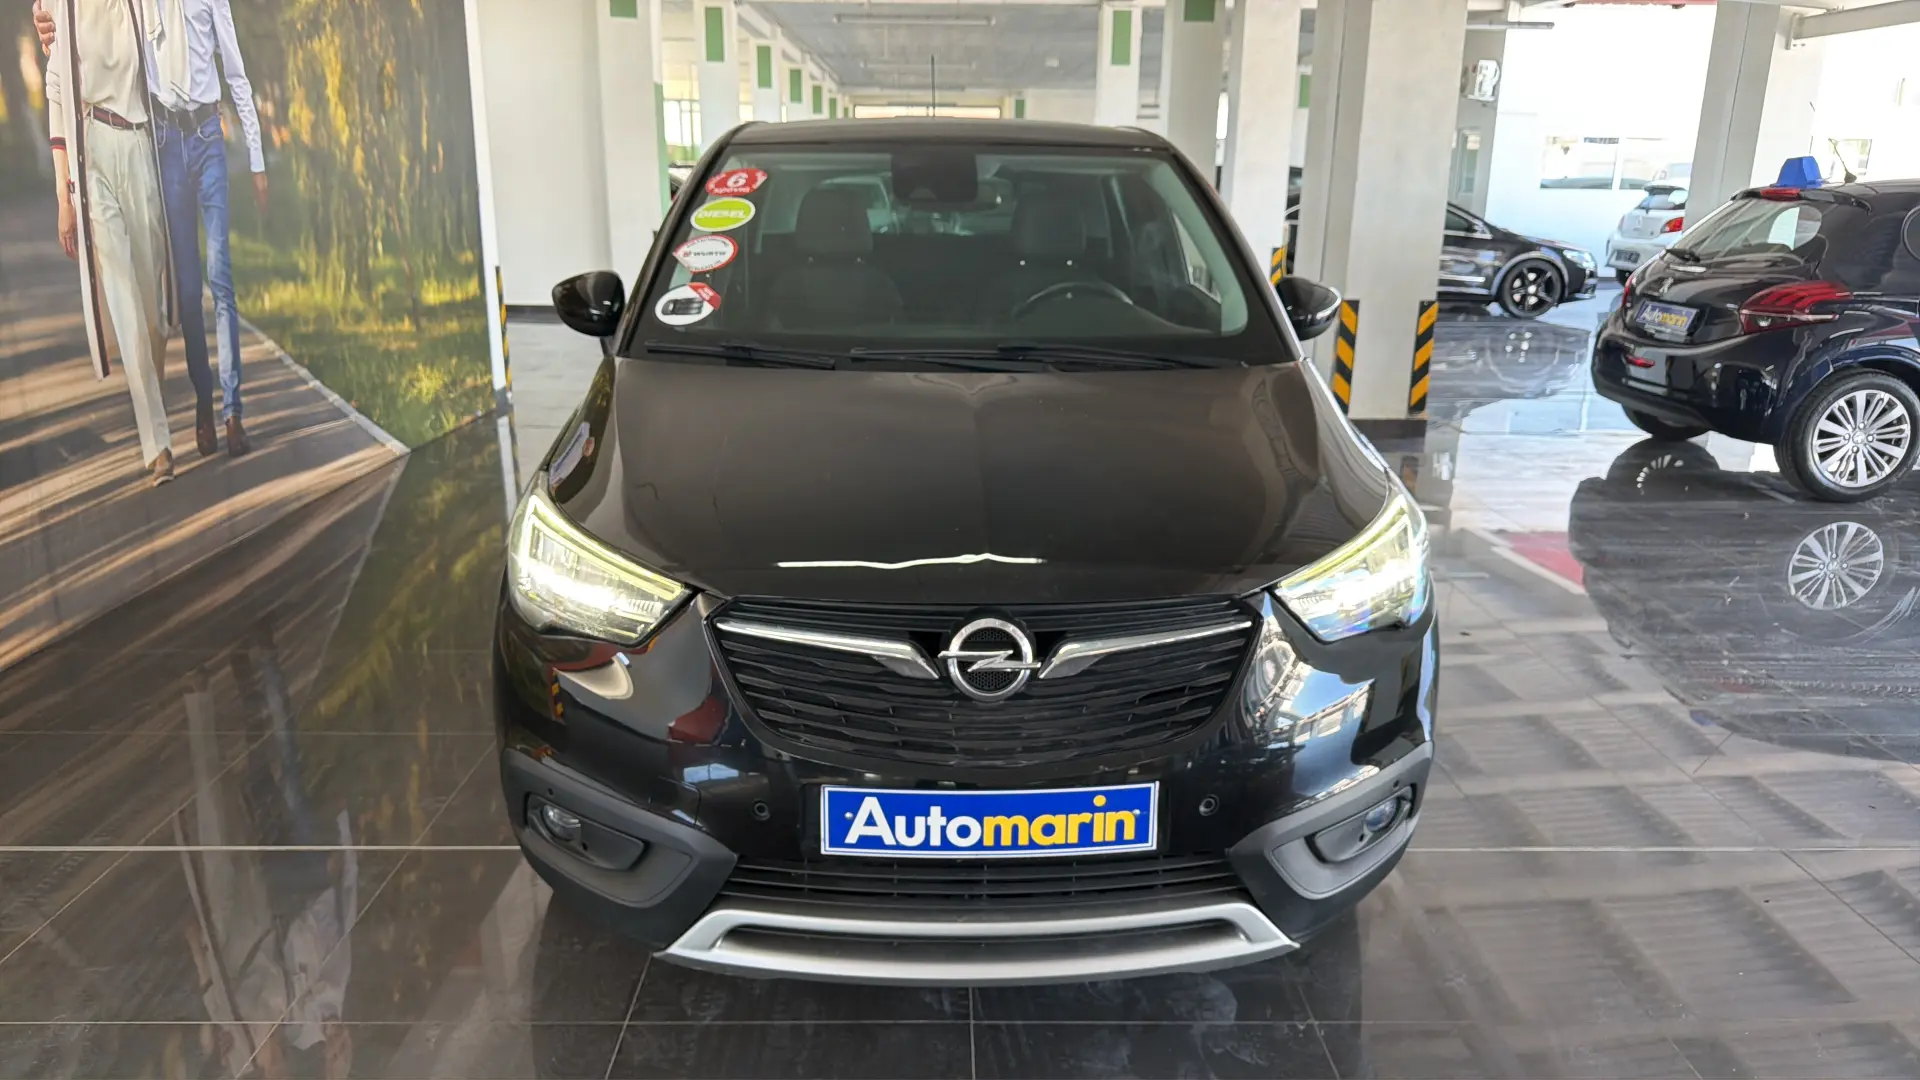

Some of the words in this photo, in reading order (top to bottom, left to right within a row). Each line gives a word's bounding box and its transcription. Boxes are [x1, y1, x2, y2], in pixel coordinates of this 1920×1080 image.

[727, 172, 748, 188] 6
[698, 209, 746, 218] DIESEL
[1640, 304, 1688, 327] Automarin
[844, 795, 1136, 847] Automarin
